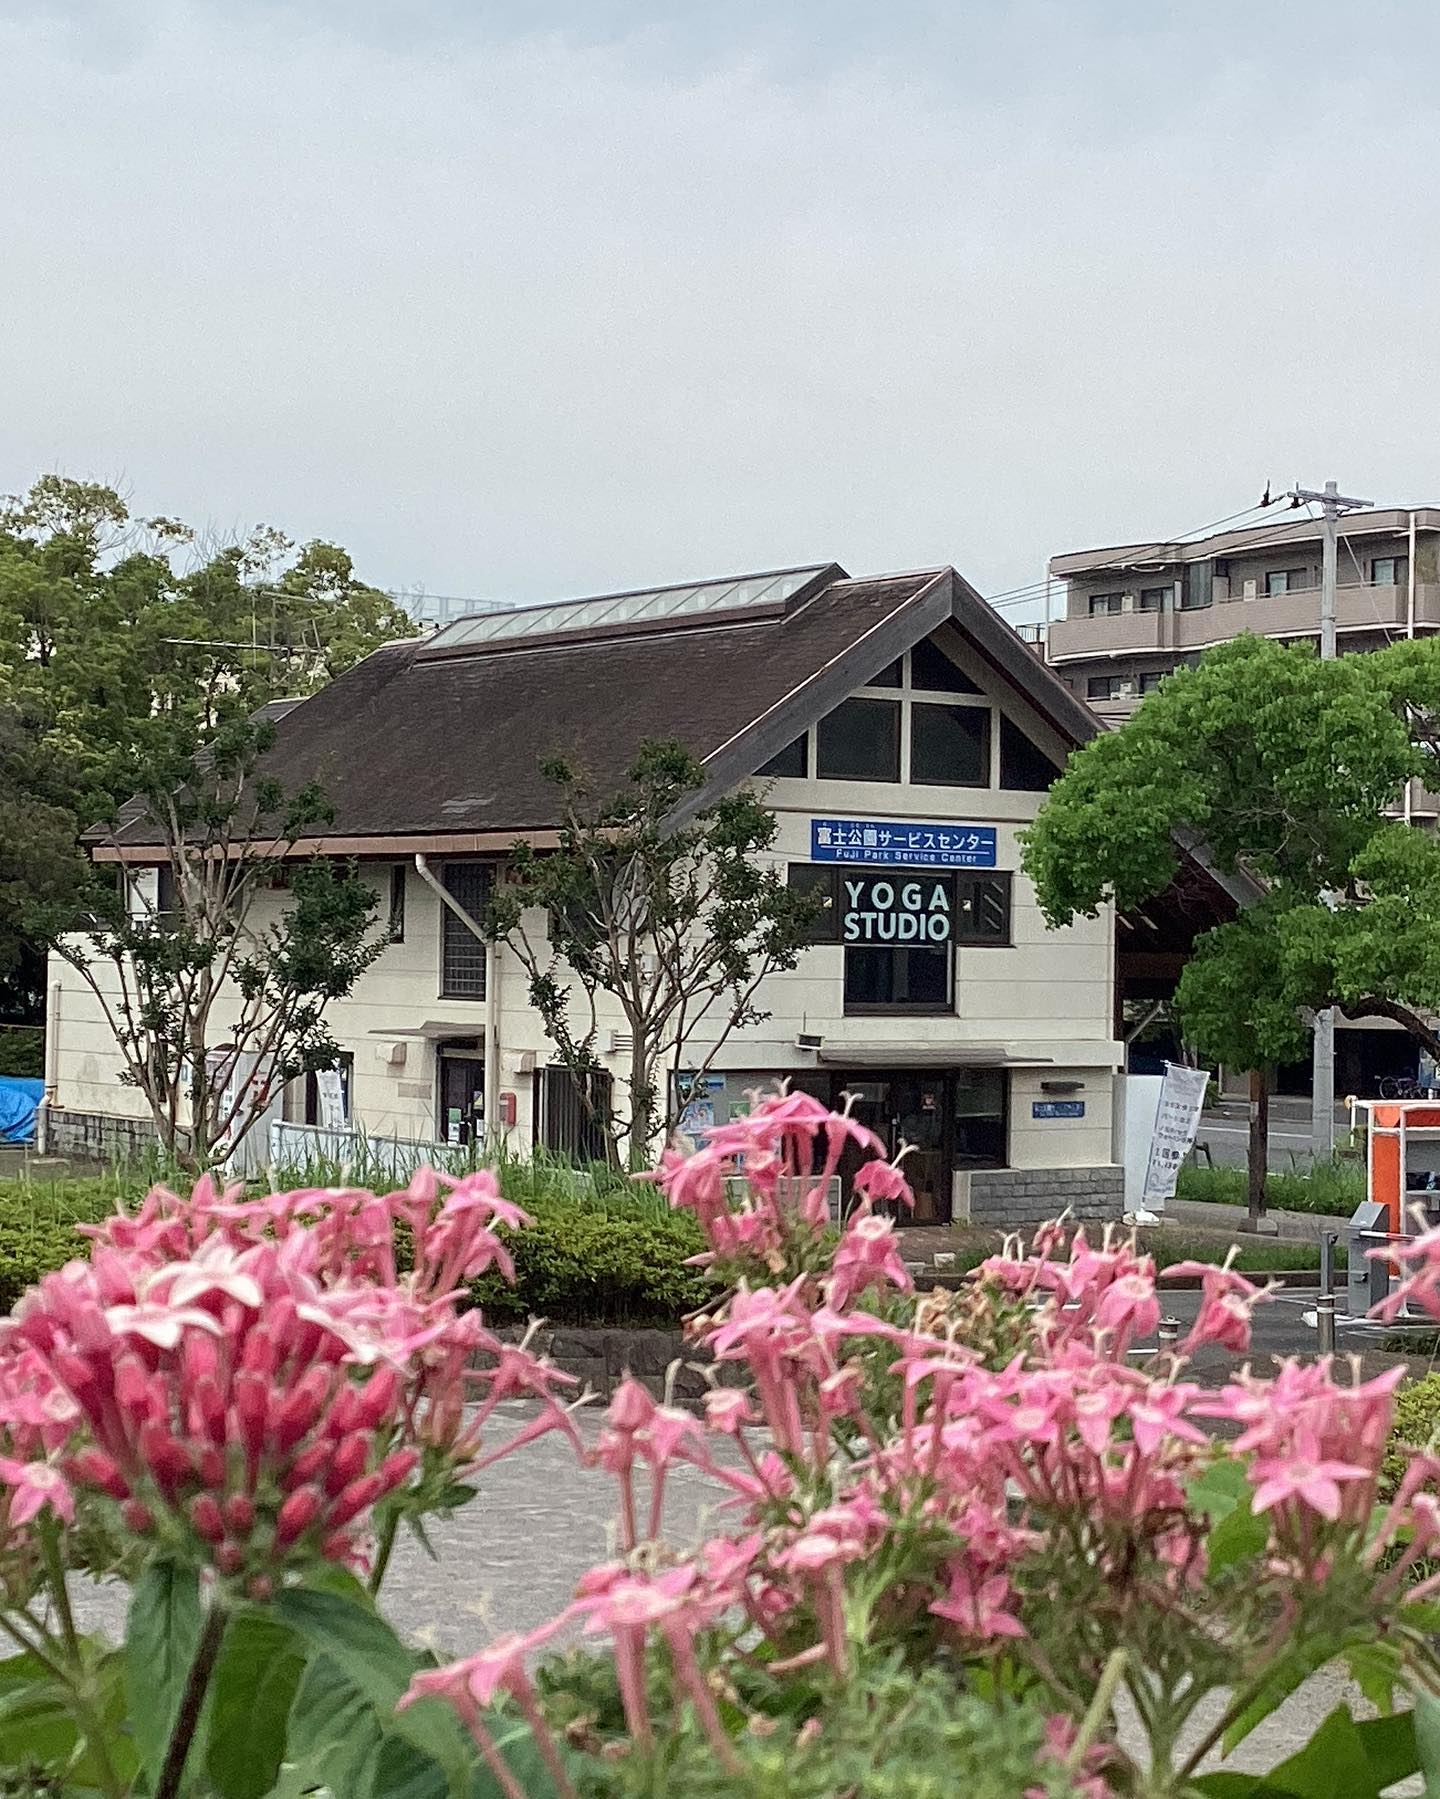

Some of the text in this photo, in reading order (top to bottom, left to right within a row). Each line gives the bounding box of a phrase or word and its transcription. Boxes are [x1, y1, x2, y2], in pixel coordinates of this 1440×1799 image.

[817, 827, 994, 850] 富士公園サービスセンター
[864, 850, 889, 860] Park
[895, 851, 936, 862] Service
[941, 853, 977, 863] Center
[844, 881, 949, 911] YOGA
[844, 912, 950, 941] STUDIO
